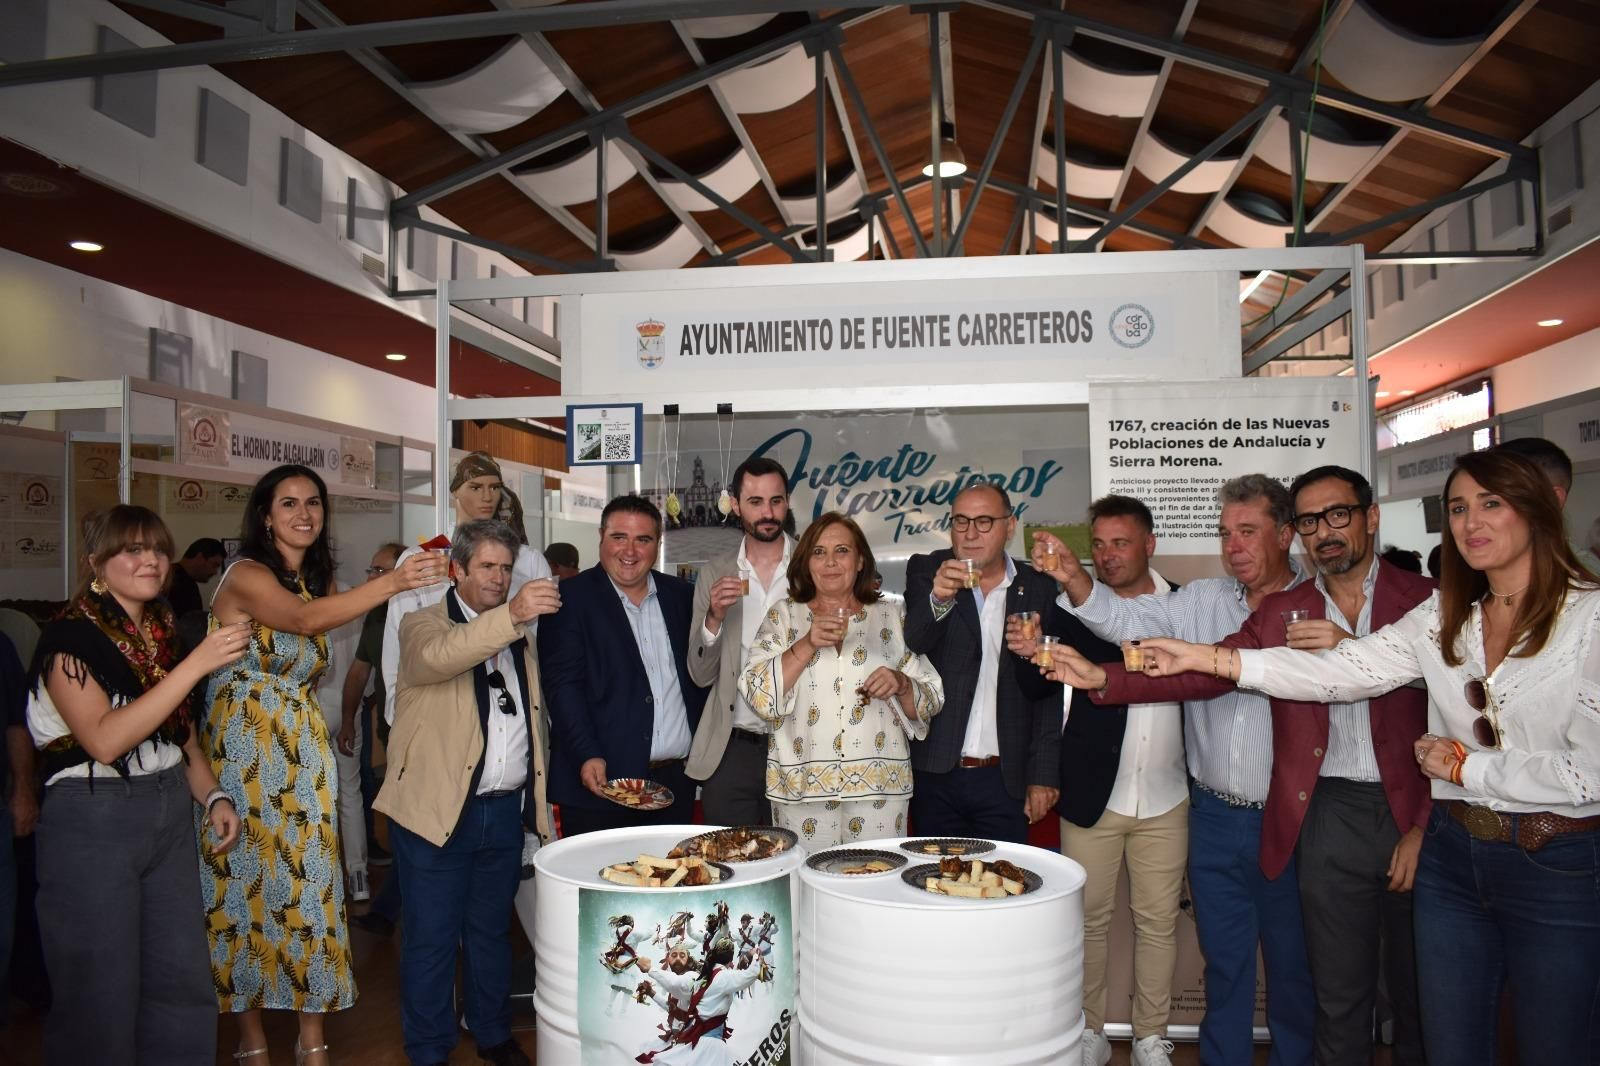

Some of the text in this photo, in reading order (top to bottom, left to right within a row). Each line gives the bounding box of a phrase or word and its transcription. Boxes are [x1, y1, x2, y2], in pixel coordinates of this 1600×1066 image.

[679, 309, 1094, 356] AYUNTAMIENTO DE FUENTE CARRETEROS
[1108, 417, 1331, 434] 1767, creación de las Nuevas
[1109, 434, 1326, 450] Poblaciones de Andalucía y
[231, 433, 242, 457] EL
[244, 436, 271, 461] HORNO
[272, 441, 282, 463] DE
[283, 443, 325, 468] ALGALLARÍN
[1109, 455, 1223, 468] Sierra Morena.
[1154, 478, 1188, 486] proyecto
[1168, 531, 1187, 539] viejo
